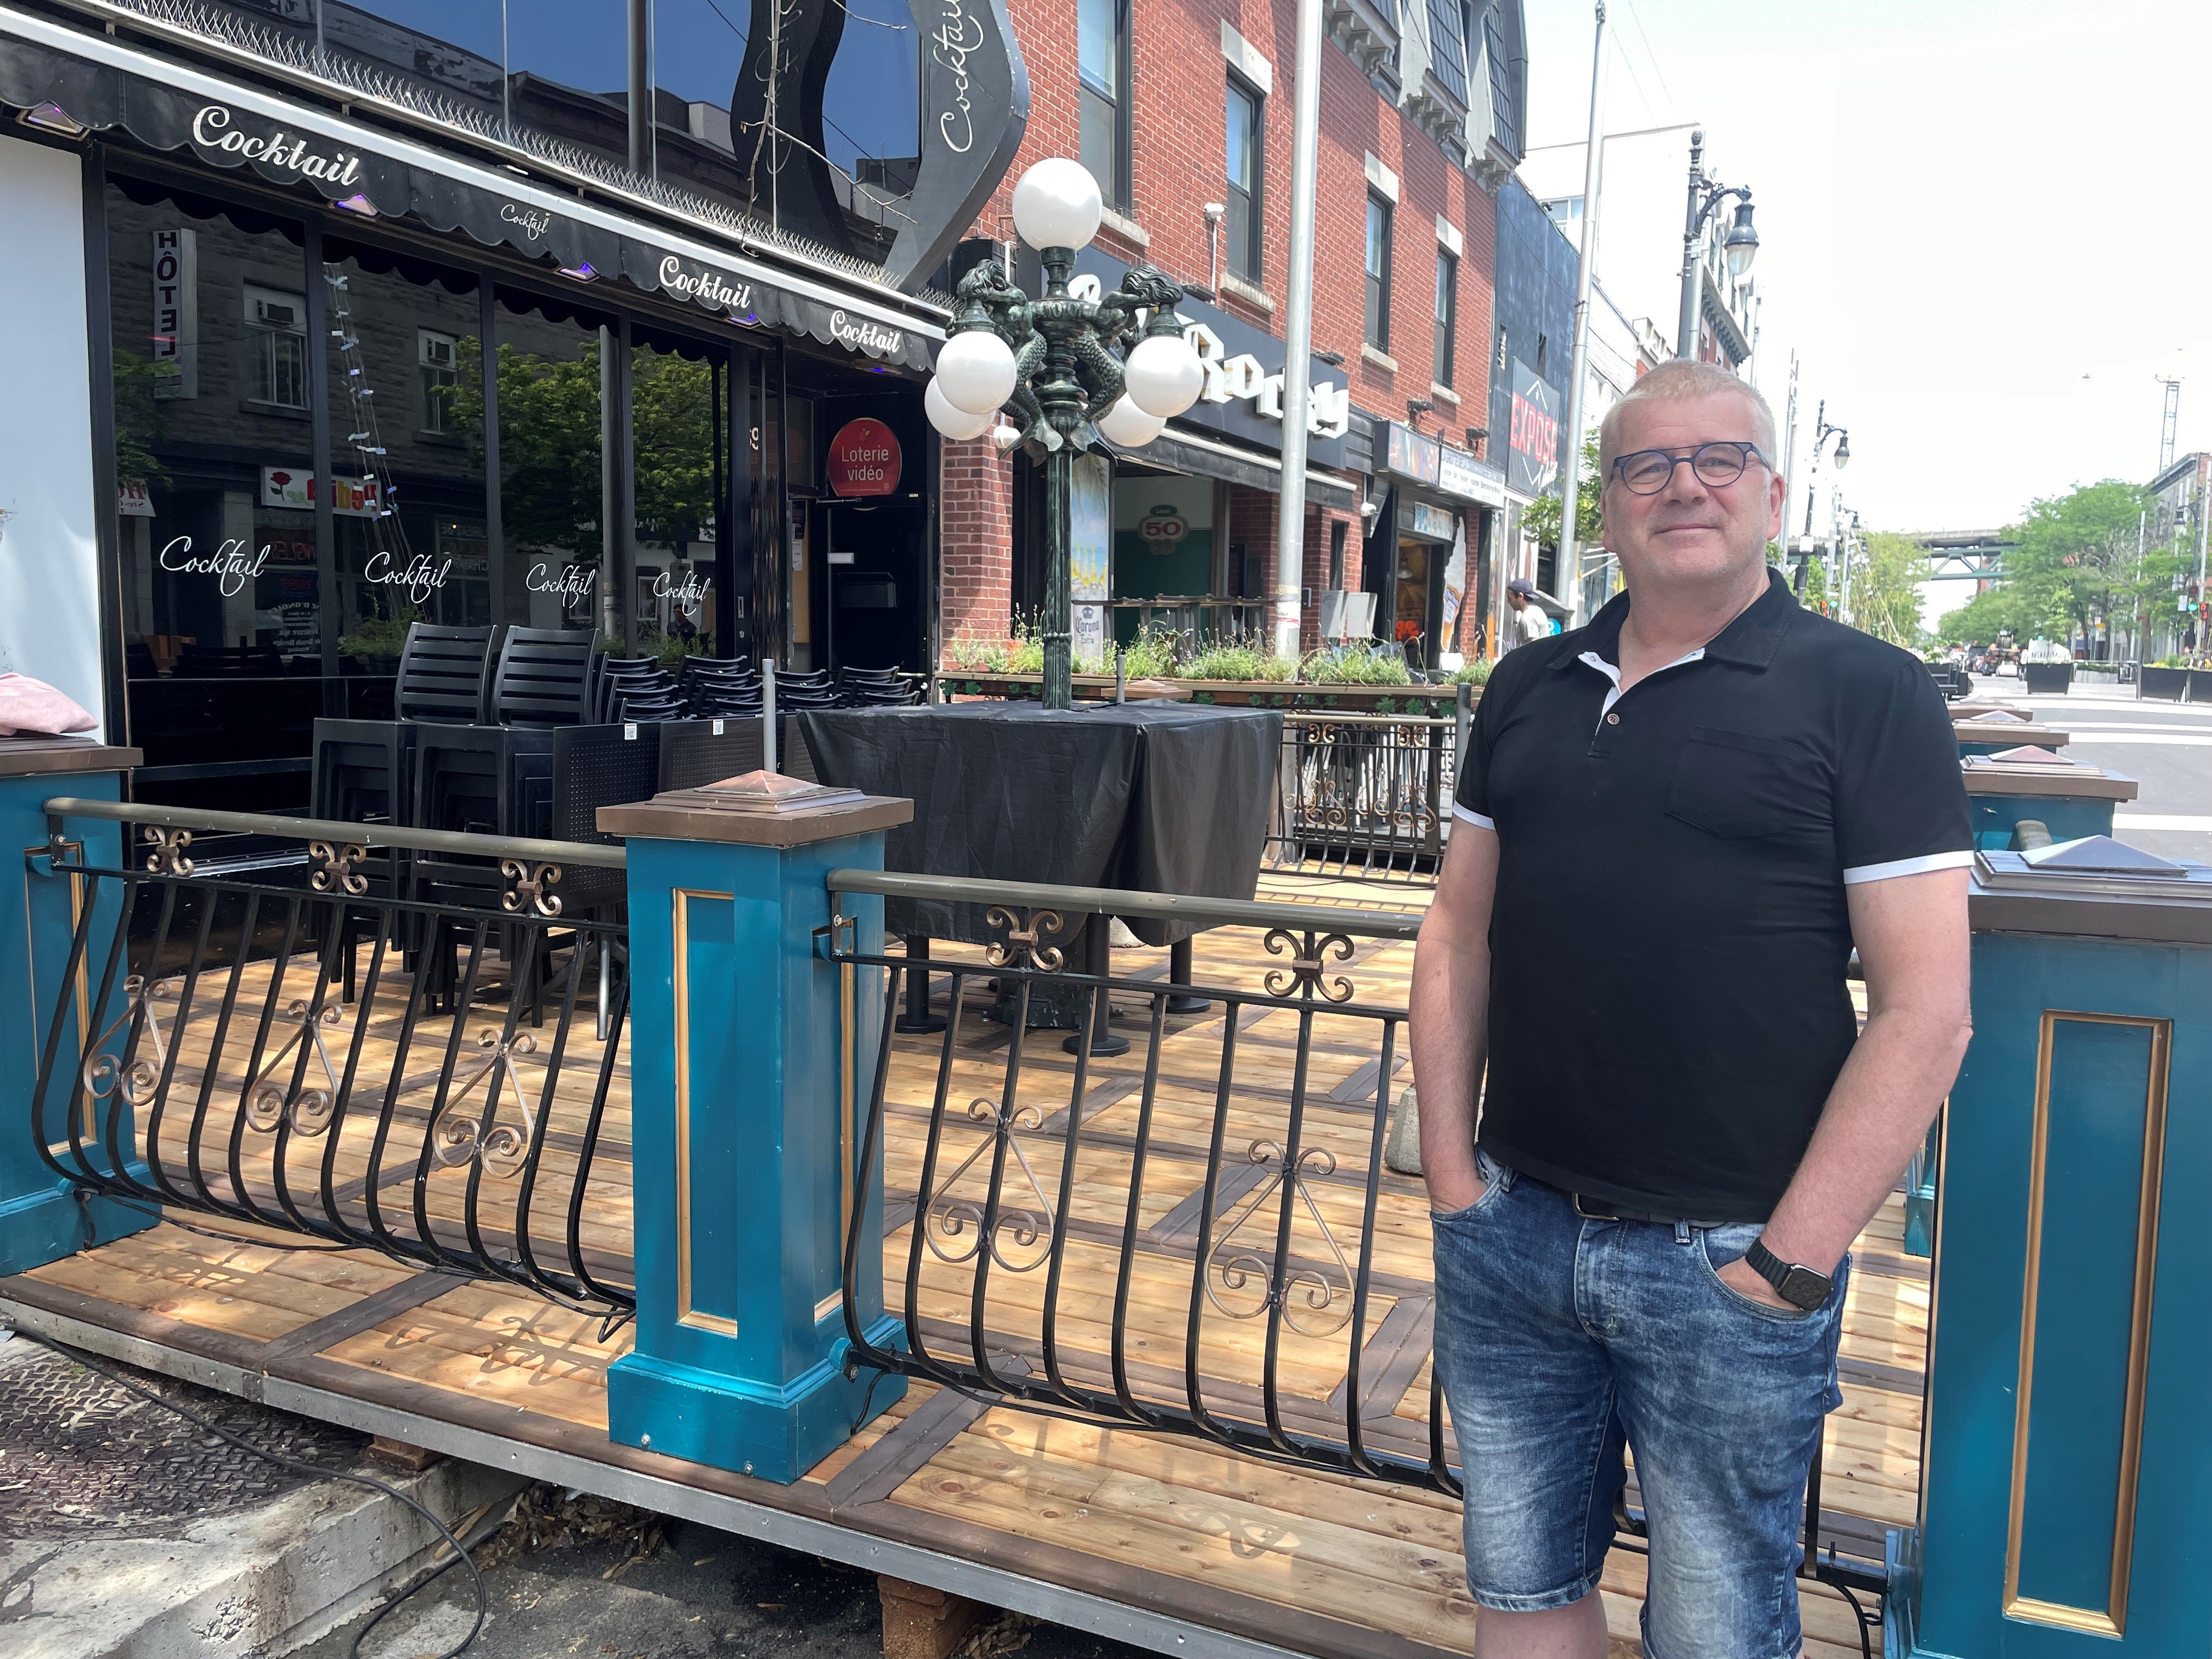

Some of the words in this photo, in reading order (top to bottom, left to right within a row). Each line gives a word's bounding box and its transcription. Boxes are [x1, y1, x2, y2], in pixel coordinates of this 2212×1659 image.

[932, 0, 984, 152] Cocktai
[193, 105, 360, 187] Cocktail
[500, 204, 550, 241] Cocktail
[659, 256, 751, 309] Cocktail
[830, 310, 901, 354] Cocktail
[842, 445, 889, 462] Loterie
[847, 465, 884, 481] vidéo
[1144, 521, 1181, 536] 50
[160, 536, 270, 597] Cocktail
[365, 552, 452, 604] Cocktail
[526, 563, 596, 608] Cocktail
[653, 571, 711, 616] Cocktail
[1075, 616, 1099, 634] Corona
[1081, 634, 1094, 644] Extra
